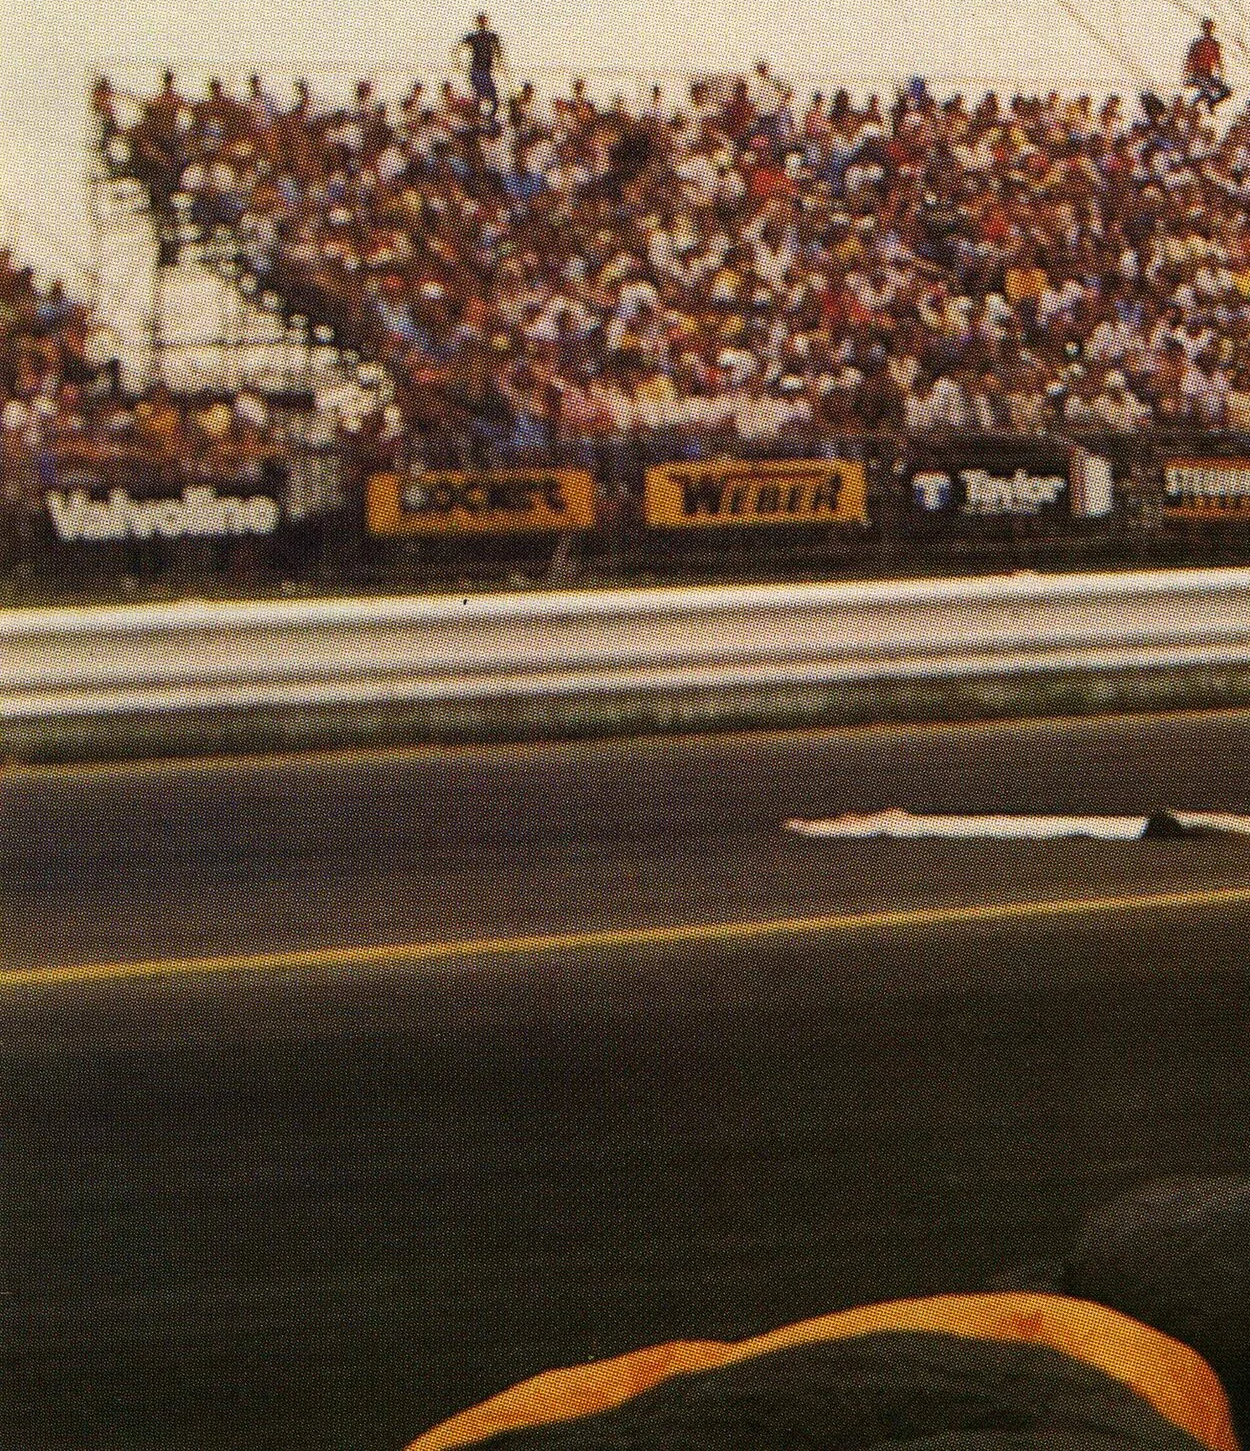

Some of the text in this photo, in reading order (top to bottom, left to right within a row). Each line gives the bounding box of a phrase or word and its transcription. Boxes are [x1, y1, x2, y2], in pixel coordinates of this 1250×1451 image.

[667, 471, 844, 516] WEBER
[957, 468, 1067, 507] Taylor
[45, 485, 279, 541] Valvoline
